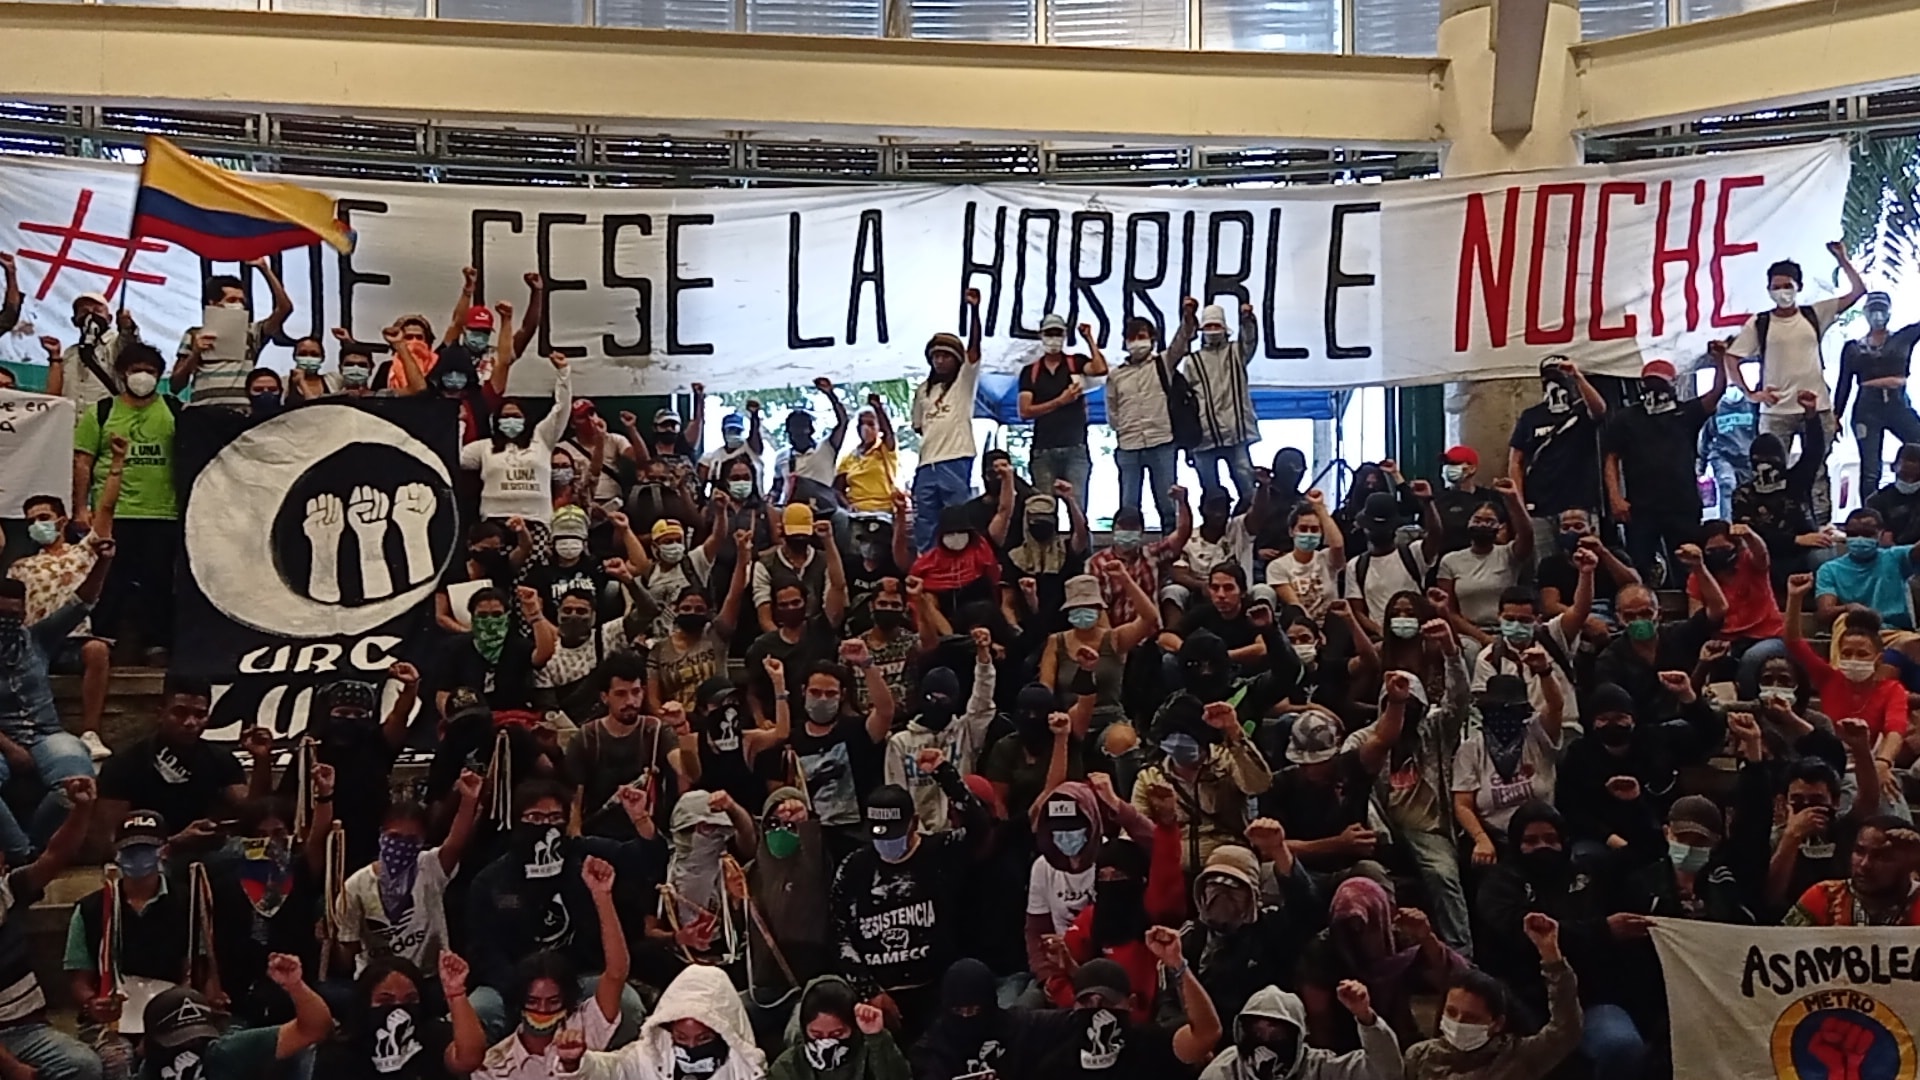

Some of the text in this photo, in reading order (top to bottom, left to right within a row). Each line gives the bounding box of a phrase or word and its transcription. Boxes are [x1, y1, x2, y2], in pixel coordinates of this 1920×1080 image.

[787, 208, 890, 350] LA
[958, 201, 1382, 360] HORRIBLE
[1454, 174, 1765, 352] NOCHE
[25, 401, 49, 411] en
[131, 445, 161, 456] LUNA
[506, 468, 536, 481] LUNA
[238, 635, 403, 674] URC
[124, 816, 157, 829] FILA
[1803, 990, 1876, 1014] METRO
